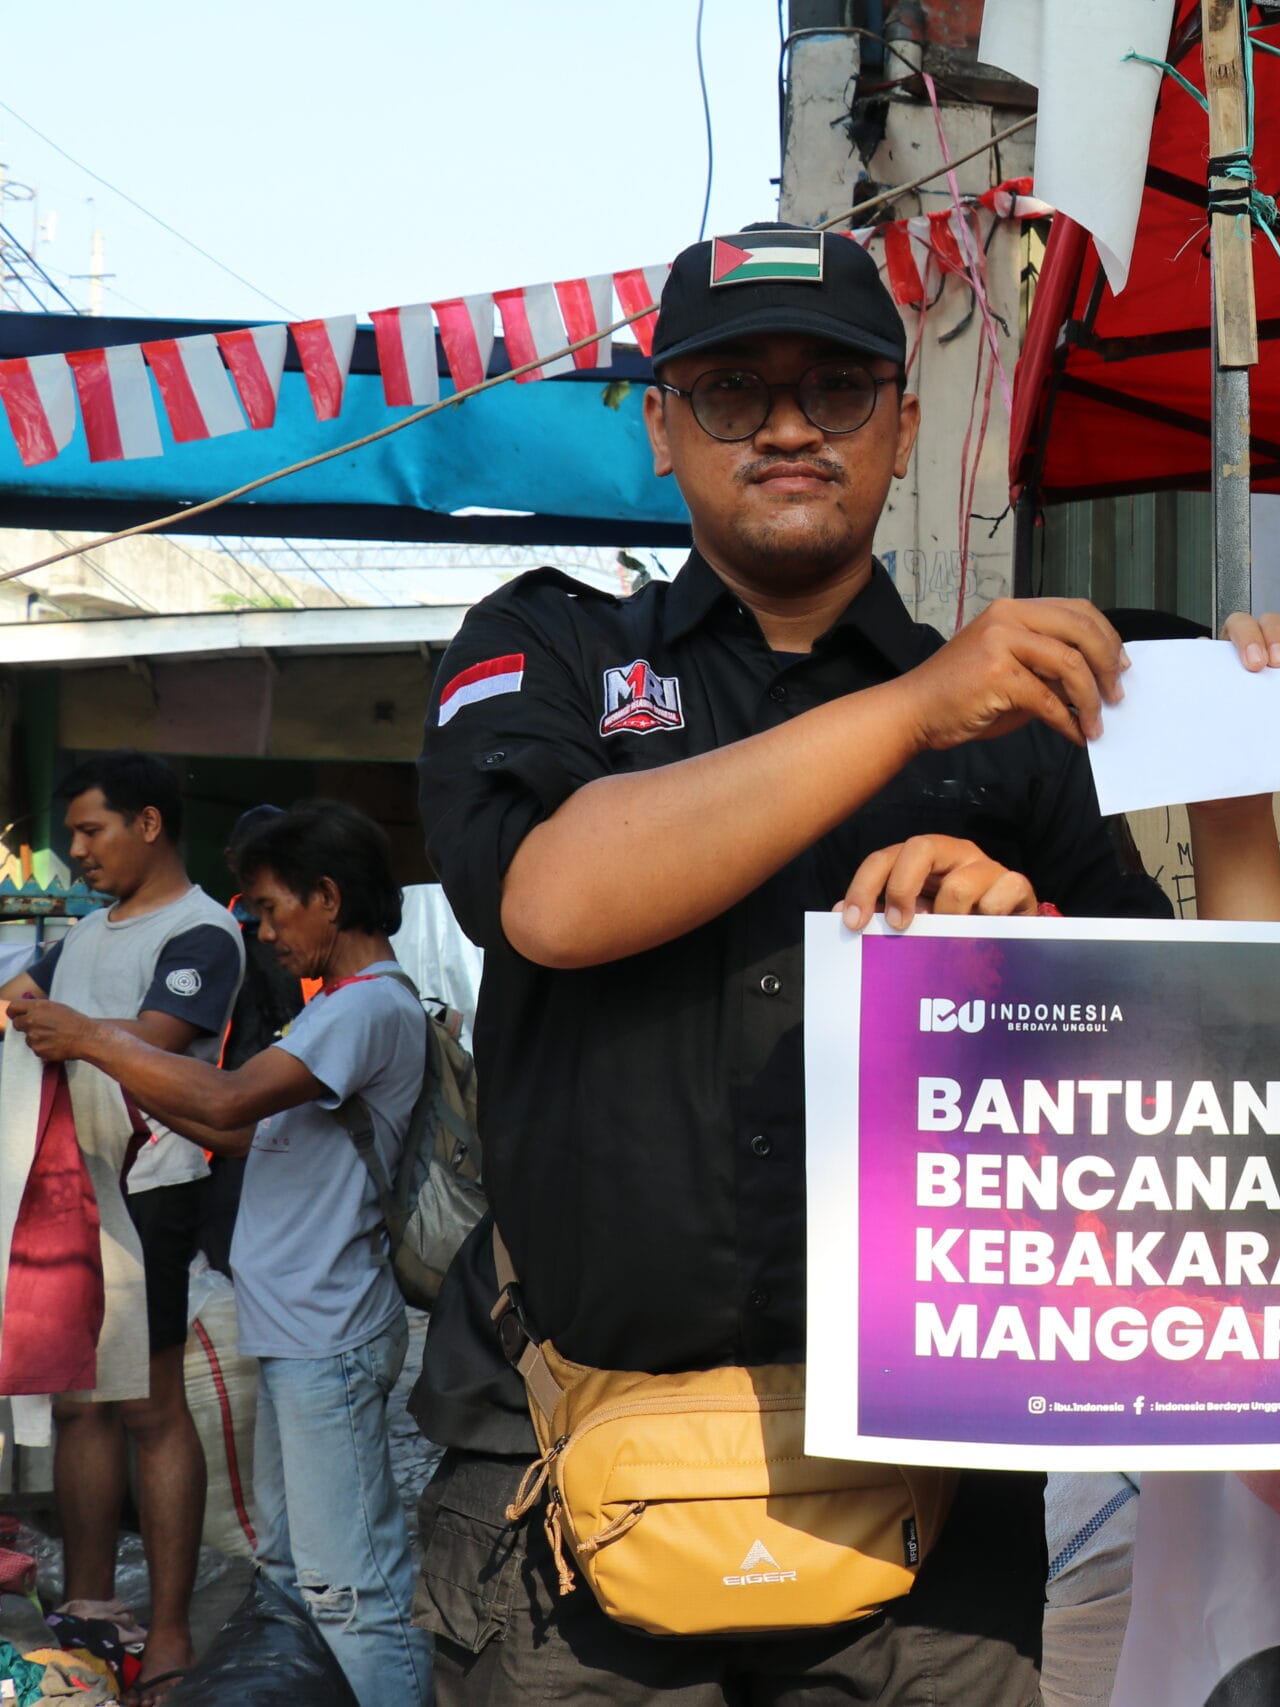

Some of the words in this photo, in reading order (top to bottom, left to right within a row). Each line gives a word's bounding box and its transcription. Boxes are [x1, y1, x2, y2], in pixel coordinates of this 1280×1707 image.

[919, 998, 986, 1033] IBU
[990, 1003, 1124, 1022] INDONESIA
[1008, 1022, 1058, 1033] BERDAYA
[1062, 1023, 1108, 1033] UNGGUL
[1206, 1401, 1250, 1413] Berdaya
[722, 1569, 798, 1588] EIGER
